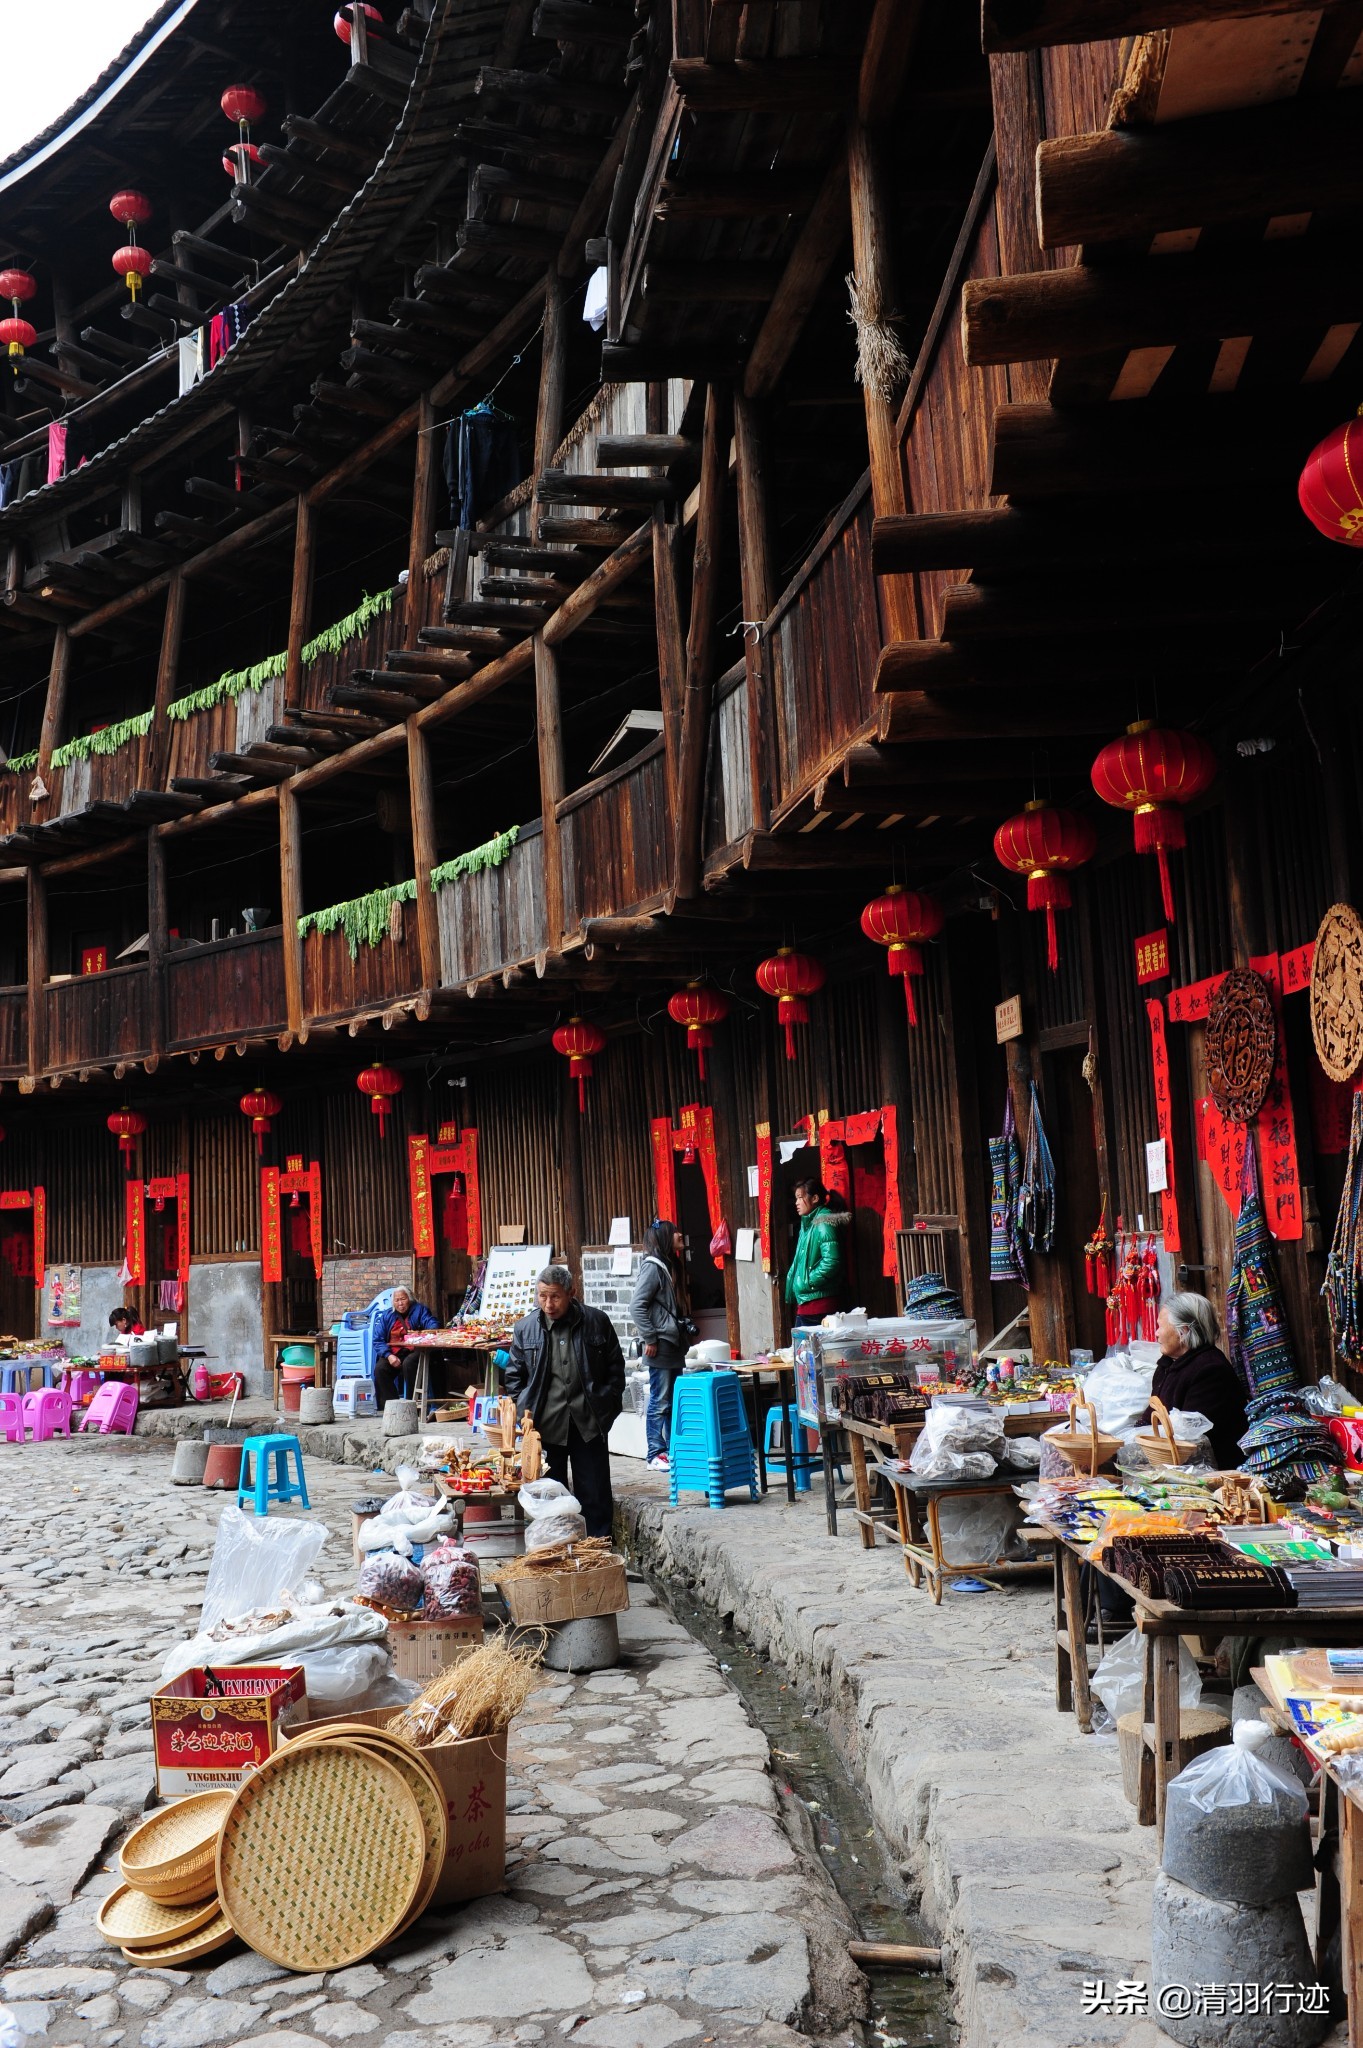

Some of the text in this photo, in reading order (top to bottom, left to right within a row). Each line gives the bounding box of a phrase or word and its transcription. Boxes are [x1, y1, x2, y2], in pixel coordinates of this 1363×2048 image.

[1137, 940, 1166, 977] 免费看井
[861, 1337, 933, 1356] 游客欢
[171, 1728, 254, 1753] 茅台迎宾酒
[186, 1773, 242, 1782] YINGBINJIU
